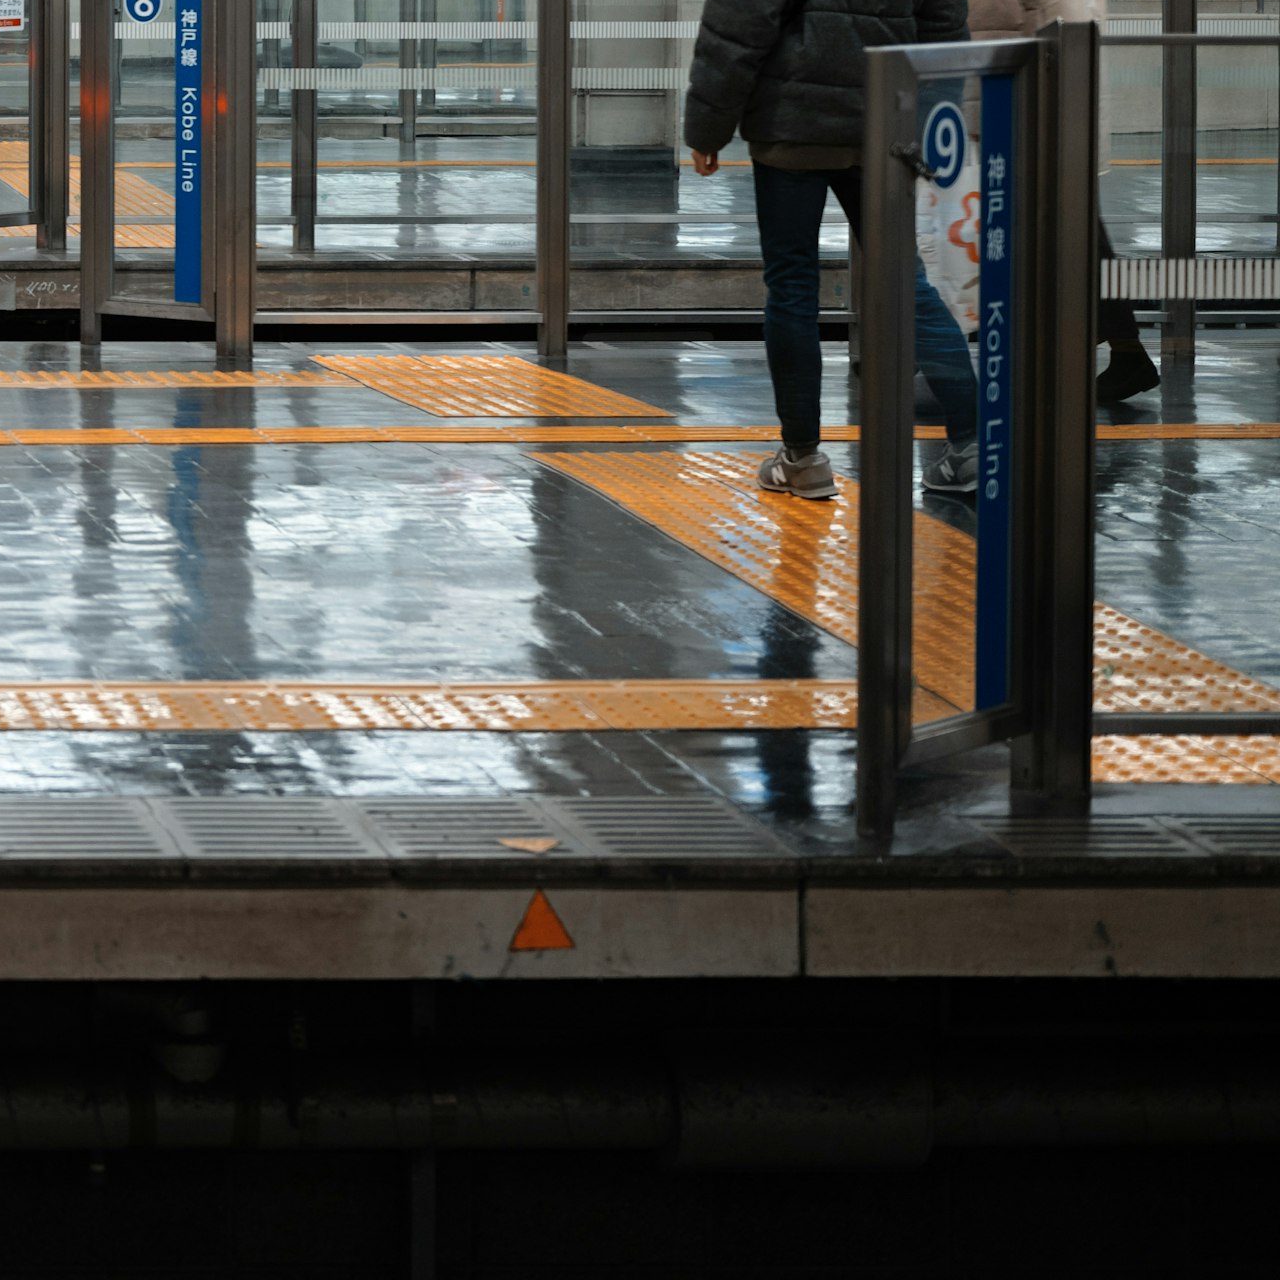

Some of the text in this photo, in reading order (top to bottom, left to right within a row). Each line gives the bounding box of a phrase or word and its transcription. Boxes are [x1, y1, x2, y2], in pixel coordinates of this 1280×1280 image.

[180, 9, 198, 66] 神戸線
[181, 87, 197, 192] Kobe Line
[935, 118, 958, 178] 9
[986, 154, 1005, 261] 神戸線
[986, 302, 1004, 500] Kobe Line
